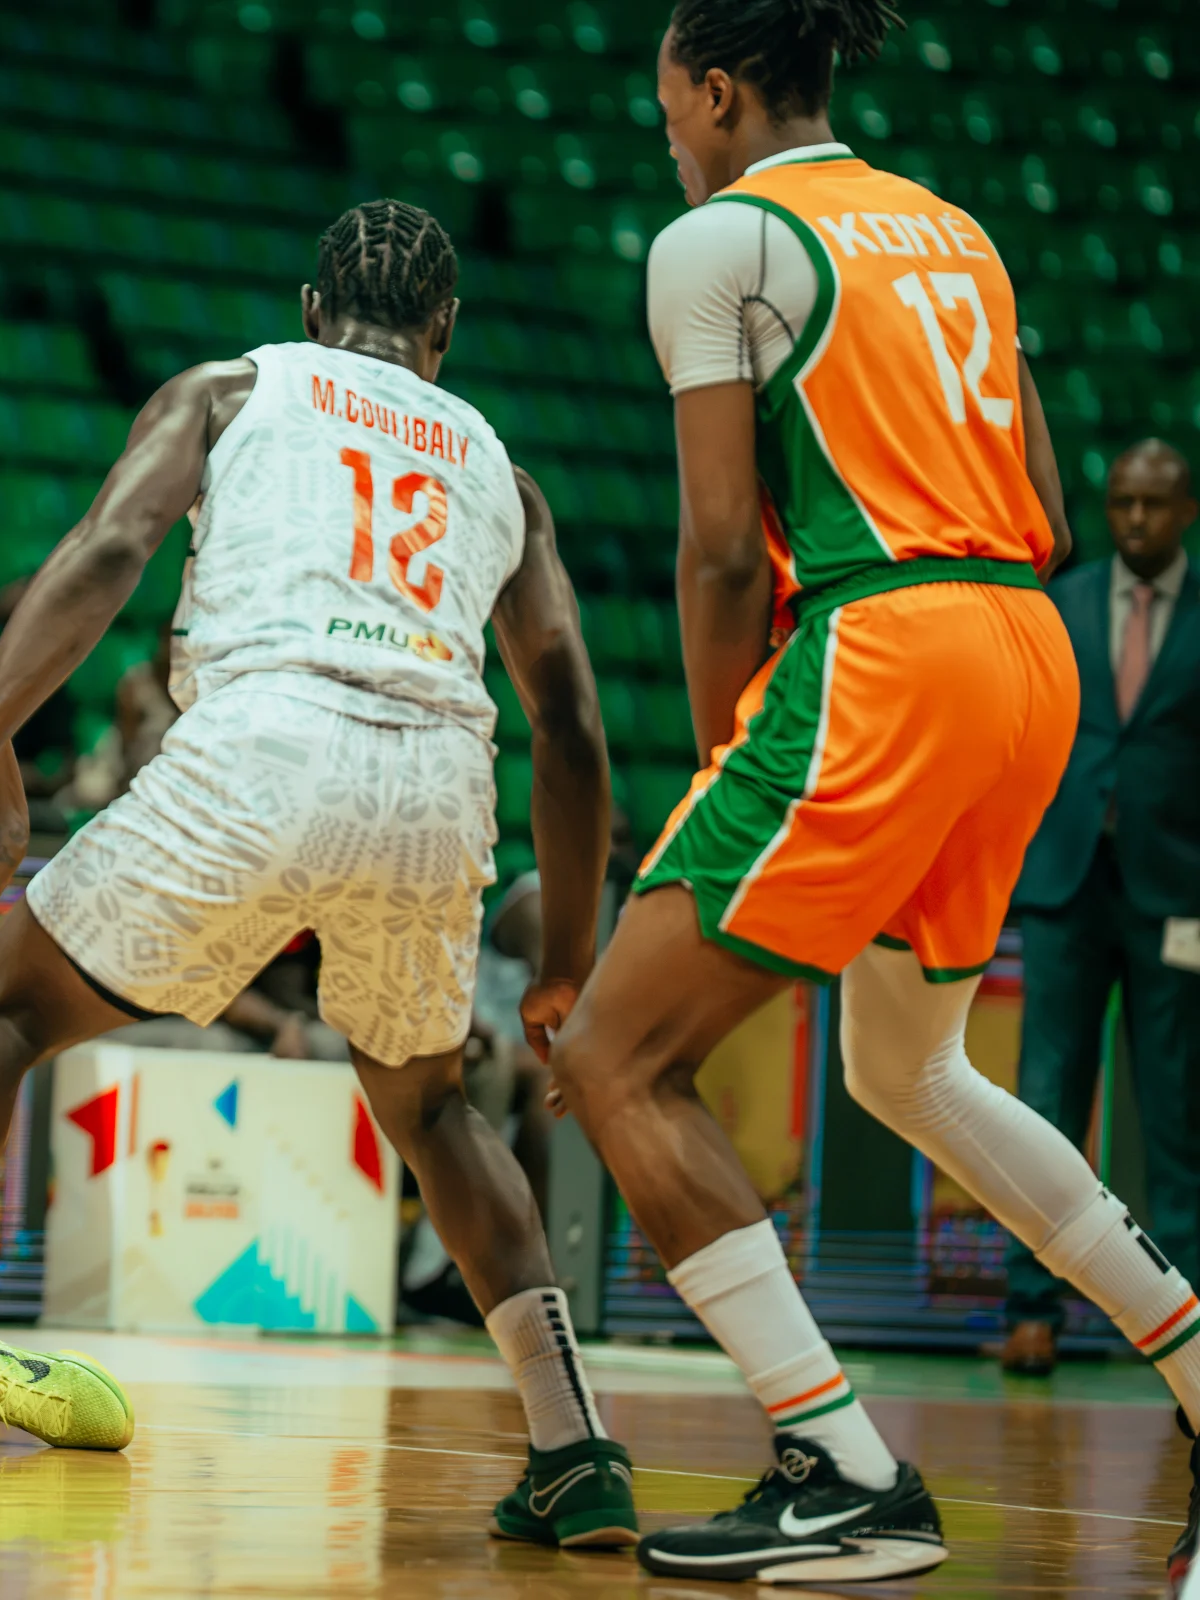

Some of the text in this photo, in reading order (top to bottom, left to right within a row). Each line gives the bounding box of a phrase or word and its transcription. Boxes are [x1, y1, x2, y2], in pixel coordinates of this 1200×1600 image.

[891, 270, 1014, 430] 12
[311, 373, 469, 469] M.COULIBALY
[339, 446, 448, 614] 12
[326, 616, 409, 648] PMU
